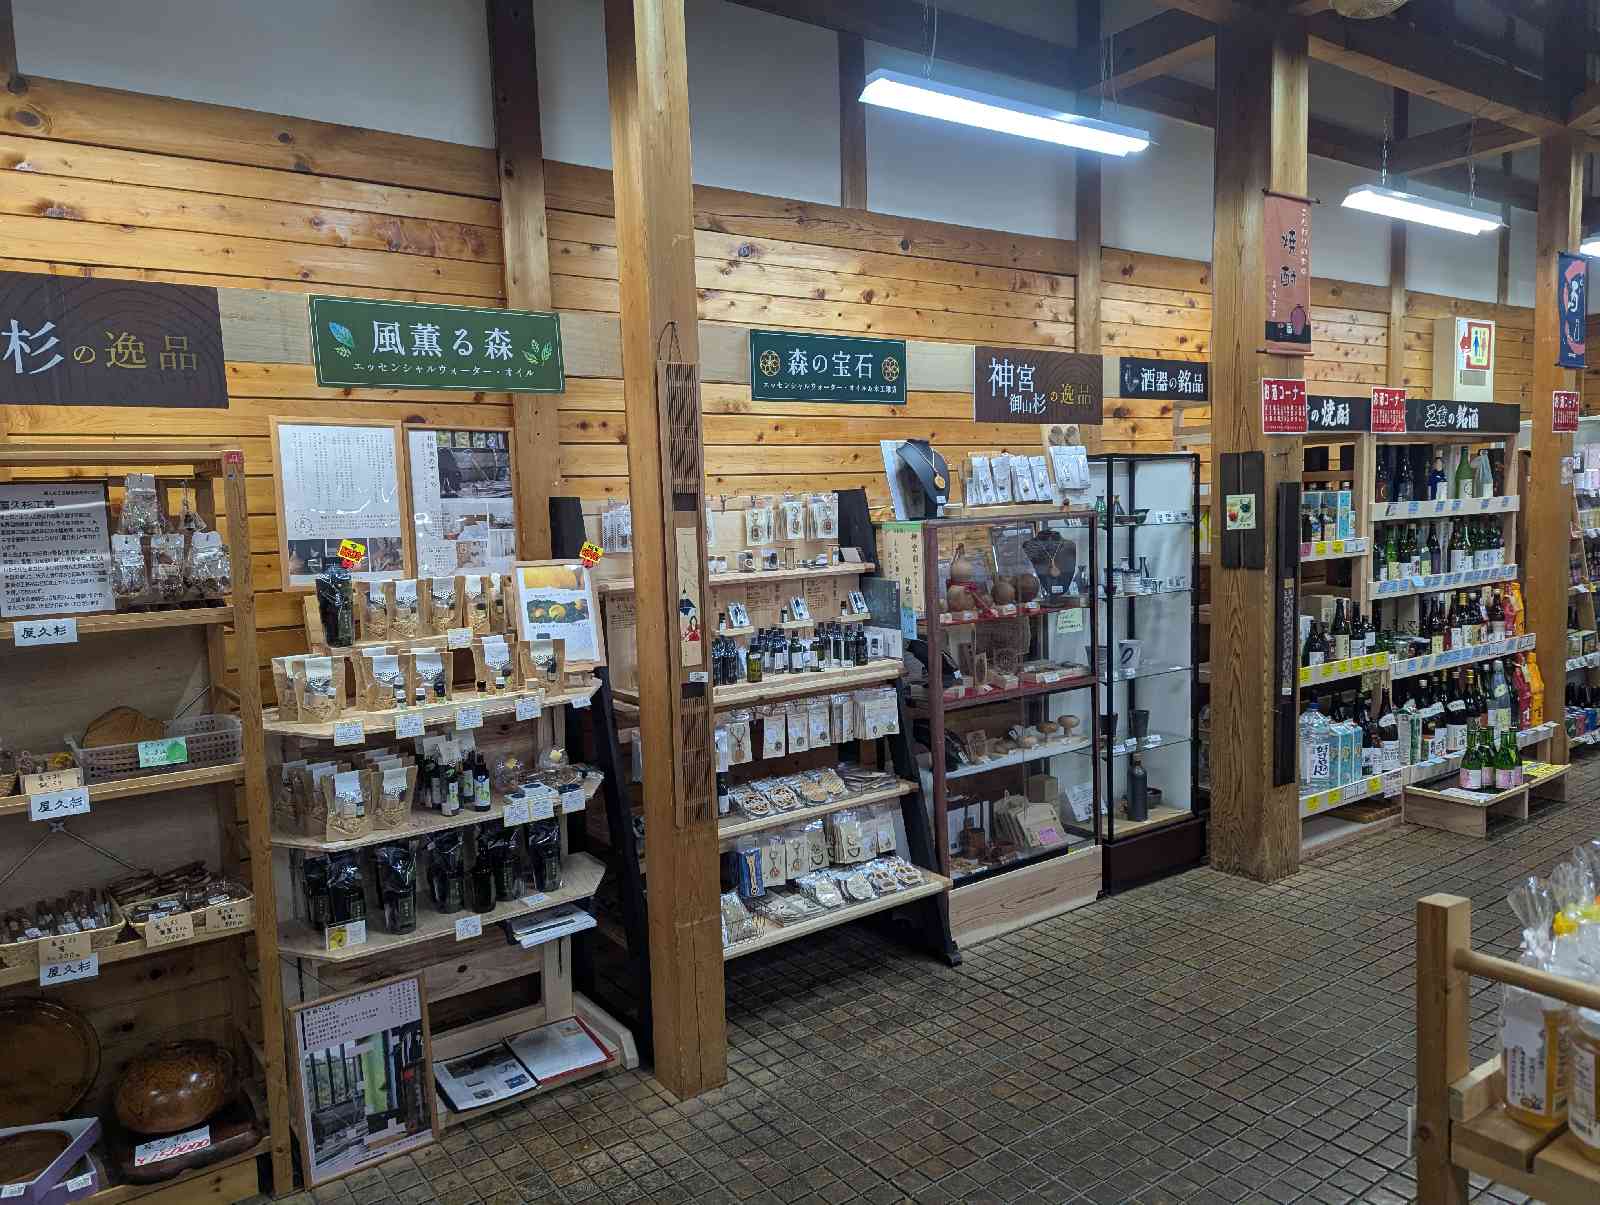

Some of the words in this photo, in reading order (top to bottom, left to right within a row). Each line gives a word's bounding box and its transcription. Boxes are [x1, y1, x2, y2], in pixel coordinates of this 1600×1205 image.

[2, 318, 199, 377] 杉の逸品
[372, 320, 514, 361] 風薫る森
[787, 347, 874, 380] 森の宝石
[1140, 366, 1204, 394] 酒器の銘品
[1308, 398, 1351, 428] の焼酎
